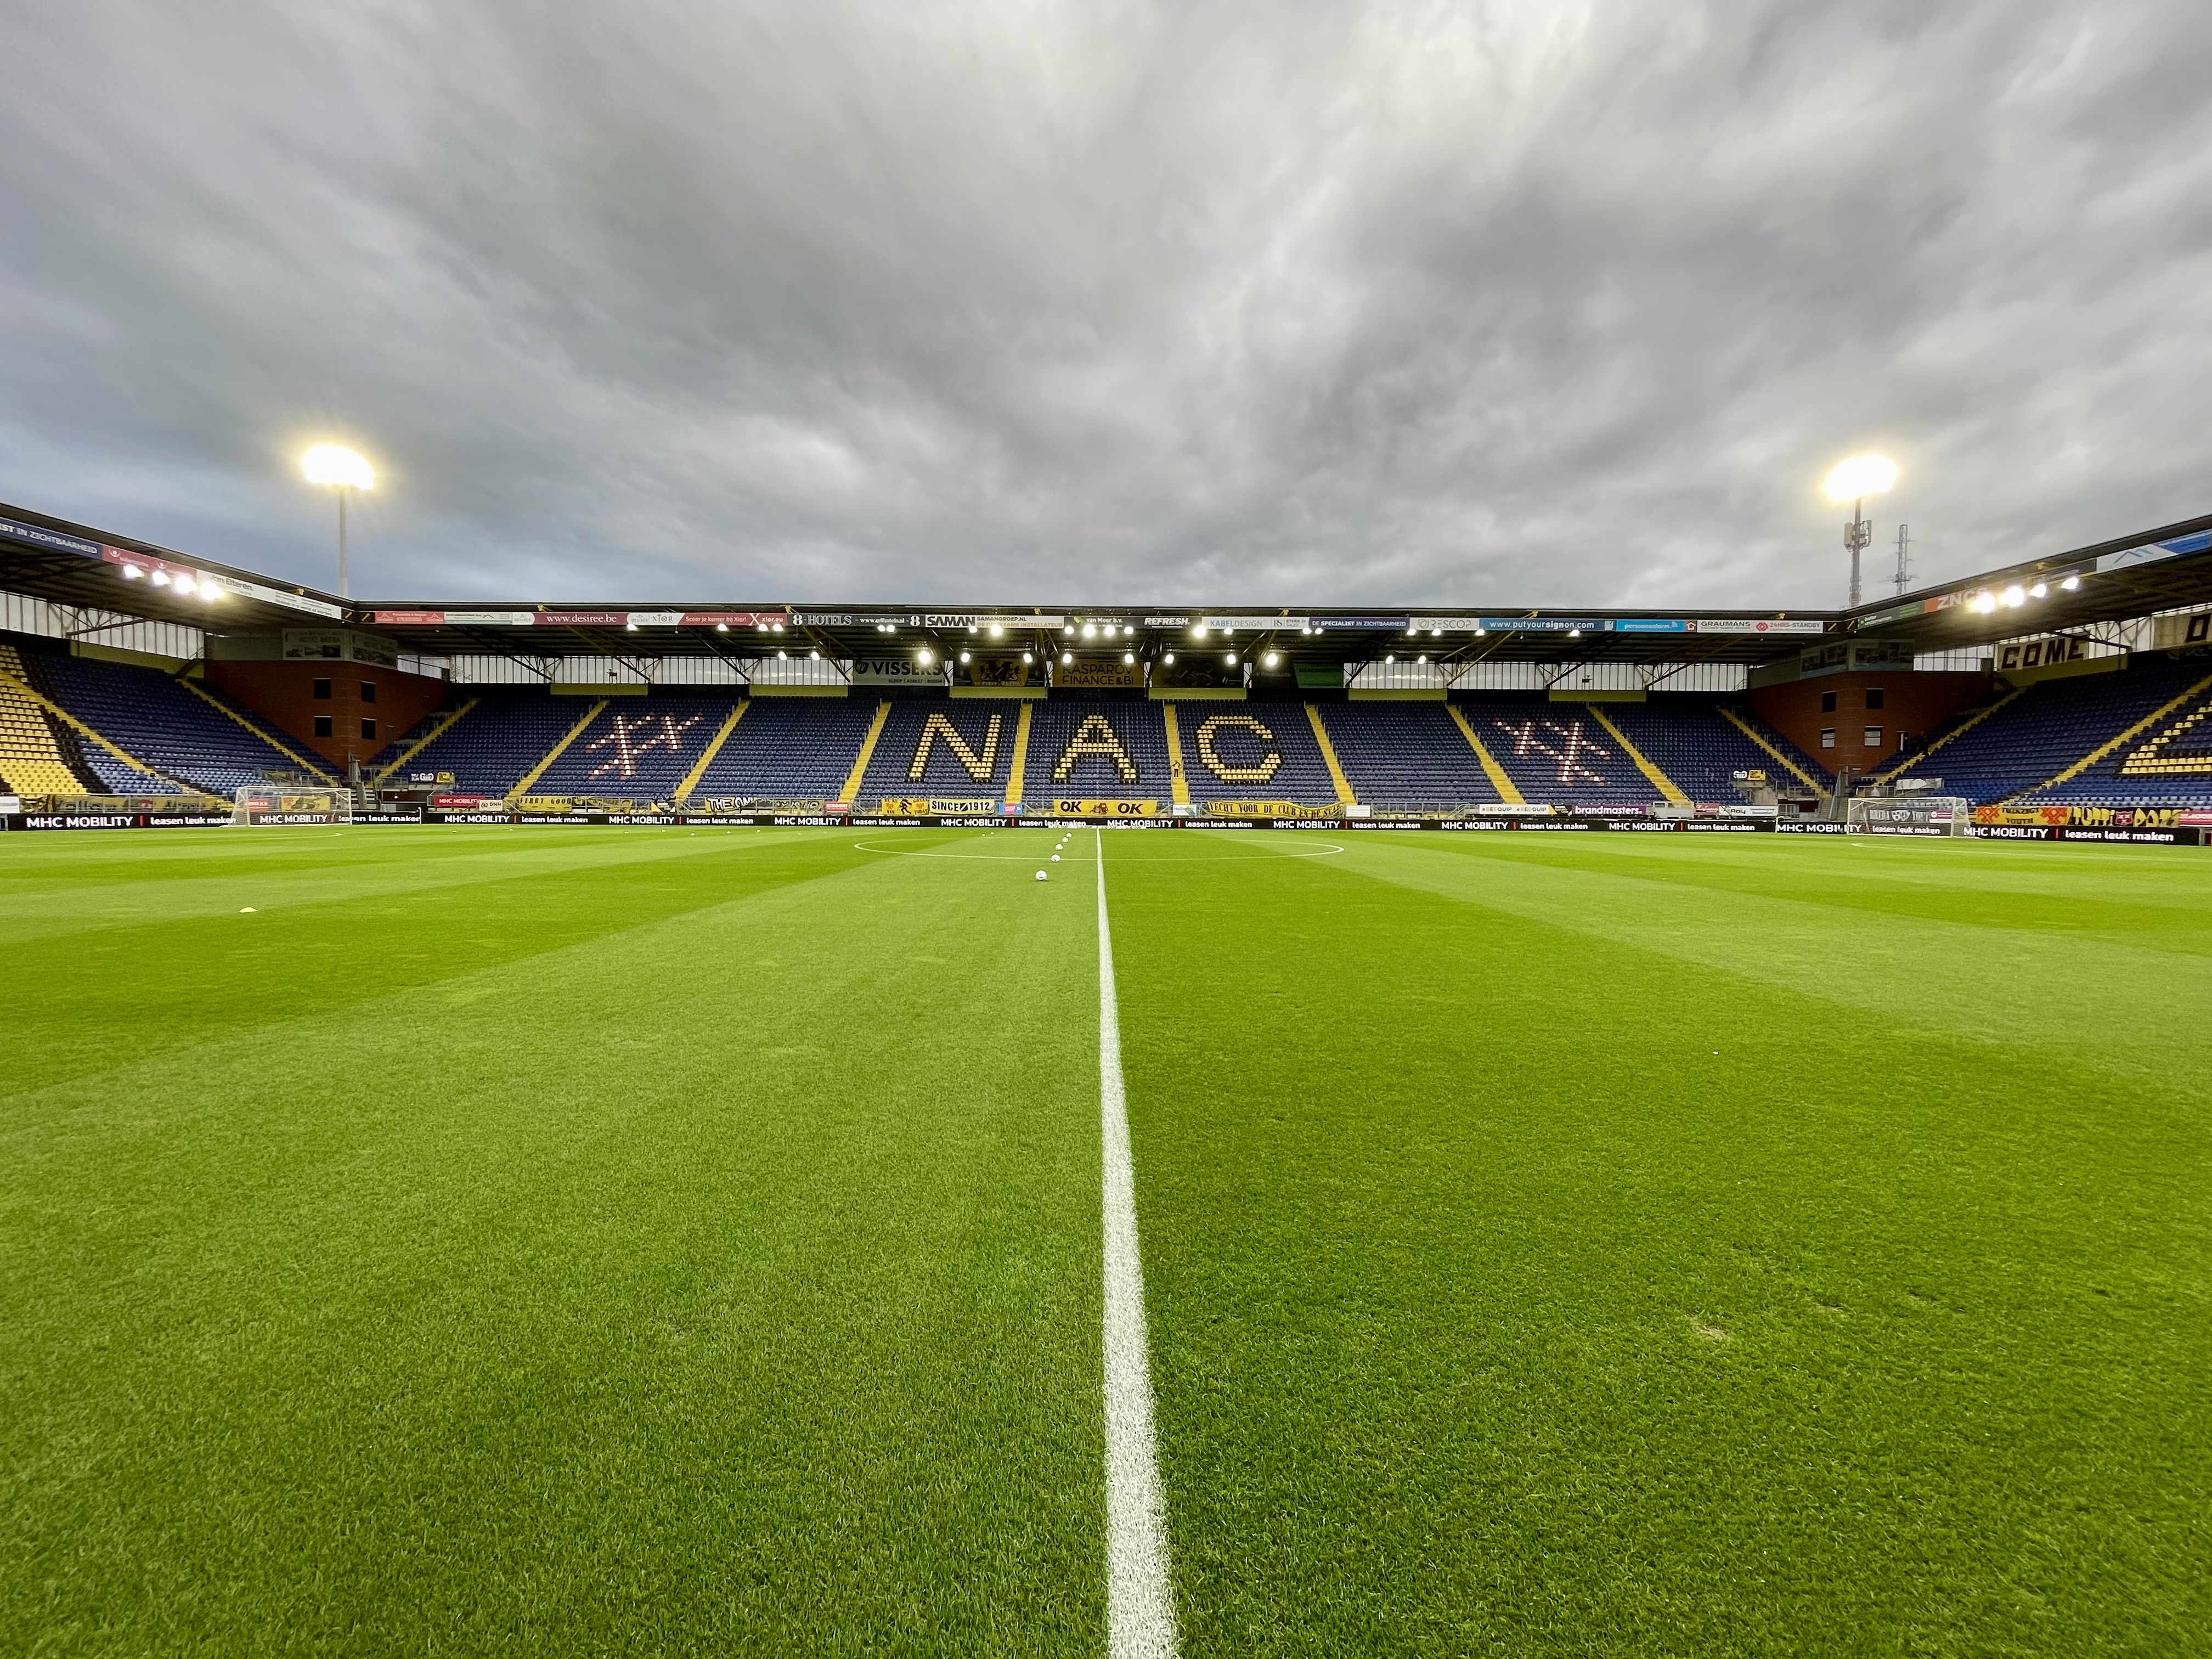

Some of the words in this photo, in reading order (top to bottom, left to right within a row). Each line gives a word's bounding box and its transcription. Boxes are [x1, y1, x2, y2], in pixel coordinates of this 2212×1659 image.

[16, 528, 27, 536] IN
[30, 531, 98, 554] ZICHTBAARHEID
[546, 614, 617, 623] www.desiree.be
[927, 616, 975, 627] SAMAN
[1431, 620, 1471, 628] RESCOP
[1489, 620, 1594, 630] www.putyoursignon.com
[2001, 636, 2084, 669] COME
[1063, 675, 1114, 685] FINANCE
[707, 797, 733, 812] THE
[932, 800, 959, 812] SINCE
[969, 802, 990, 811] 1912
[1060, 801, 1082, 812] OK
[1118, 803, 1143, 814] OK
[1209, 802, 1234, 812] VECHT
[1239, 804, 1259, 813] VOOR
[1263, 804, 1273, 814] DE
[1278, 805, 1296, 816] CLUB
[27, 816, 63, 827] MHC
[66, 816, 133, 827] MOBILITY
[150, 817, 182, 825] leasen
[259, 815, 283, 823] MHC
[285, 815, 328, 823] MOBILITY
[1130, 820, 1173, 828] MOBILITY
[1609, 822, 1630, 831] MHC
[1632, 822, 1675, 831] MOBILITY
[1776, 823, 1803, 832] MHC
[1806, 823, 1862, 833] MOBILITY
[1872, 825, 1895, 833] leasen
[1915, 826, 1940, 834] maken
[1963, 827, 1989, 837] MHC
[1990, 827, 2049, 838] MOBILITY
[2066, 830, 2102, 839] leasen
[2104, 831, 2130, 840] leuk
[2132, 832, 2174, 842] maken
